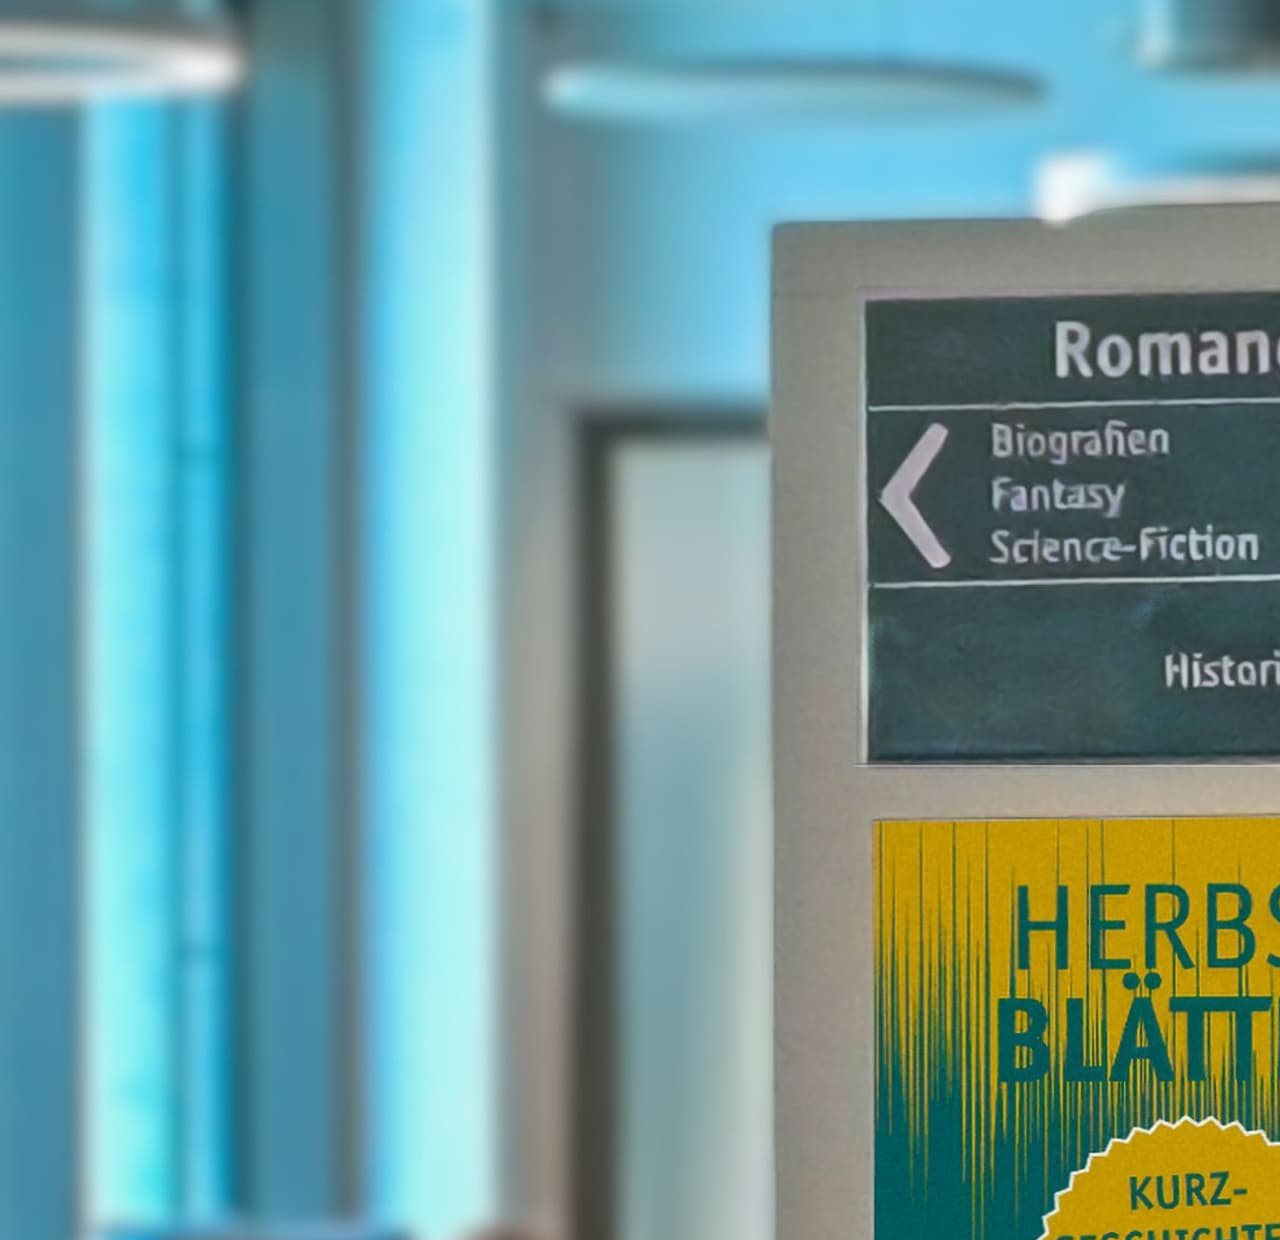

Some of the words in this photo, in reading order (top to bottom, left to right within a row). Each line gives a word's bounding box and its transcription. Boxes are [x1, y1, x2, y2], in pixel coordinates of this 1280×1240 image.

[991, 419, 1170, 465] Biografien
[991, 477, 1126, 519] Fantasy
[989, 524, 1260, 564] Science-Fiction
[1129, 1171, 1248, 1211] KURZ-
